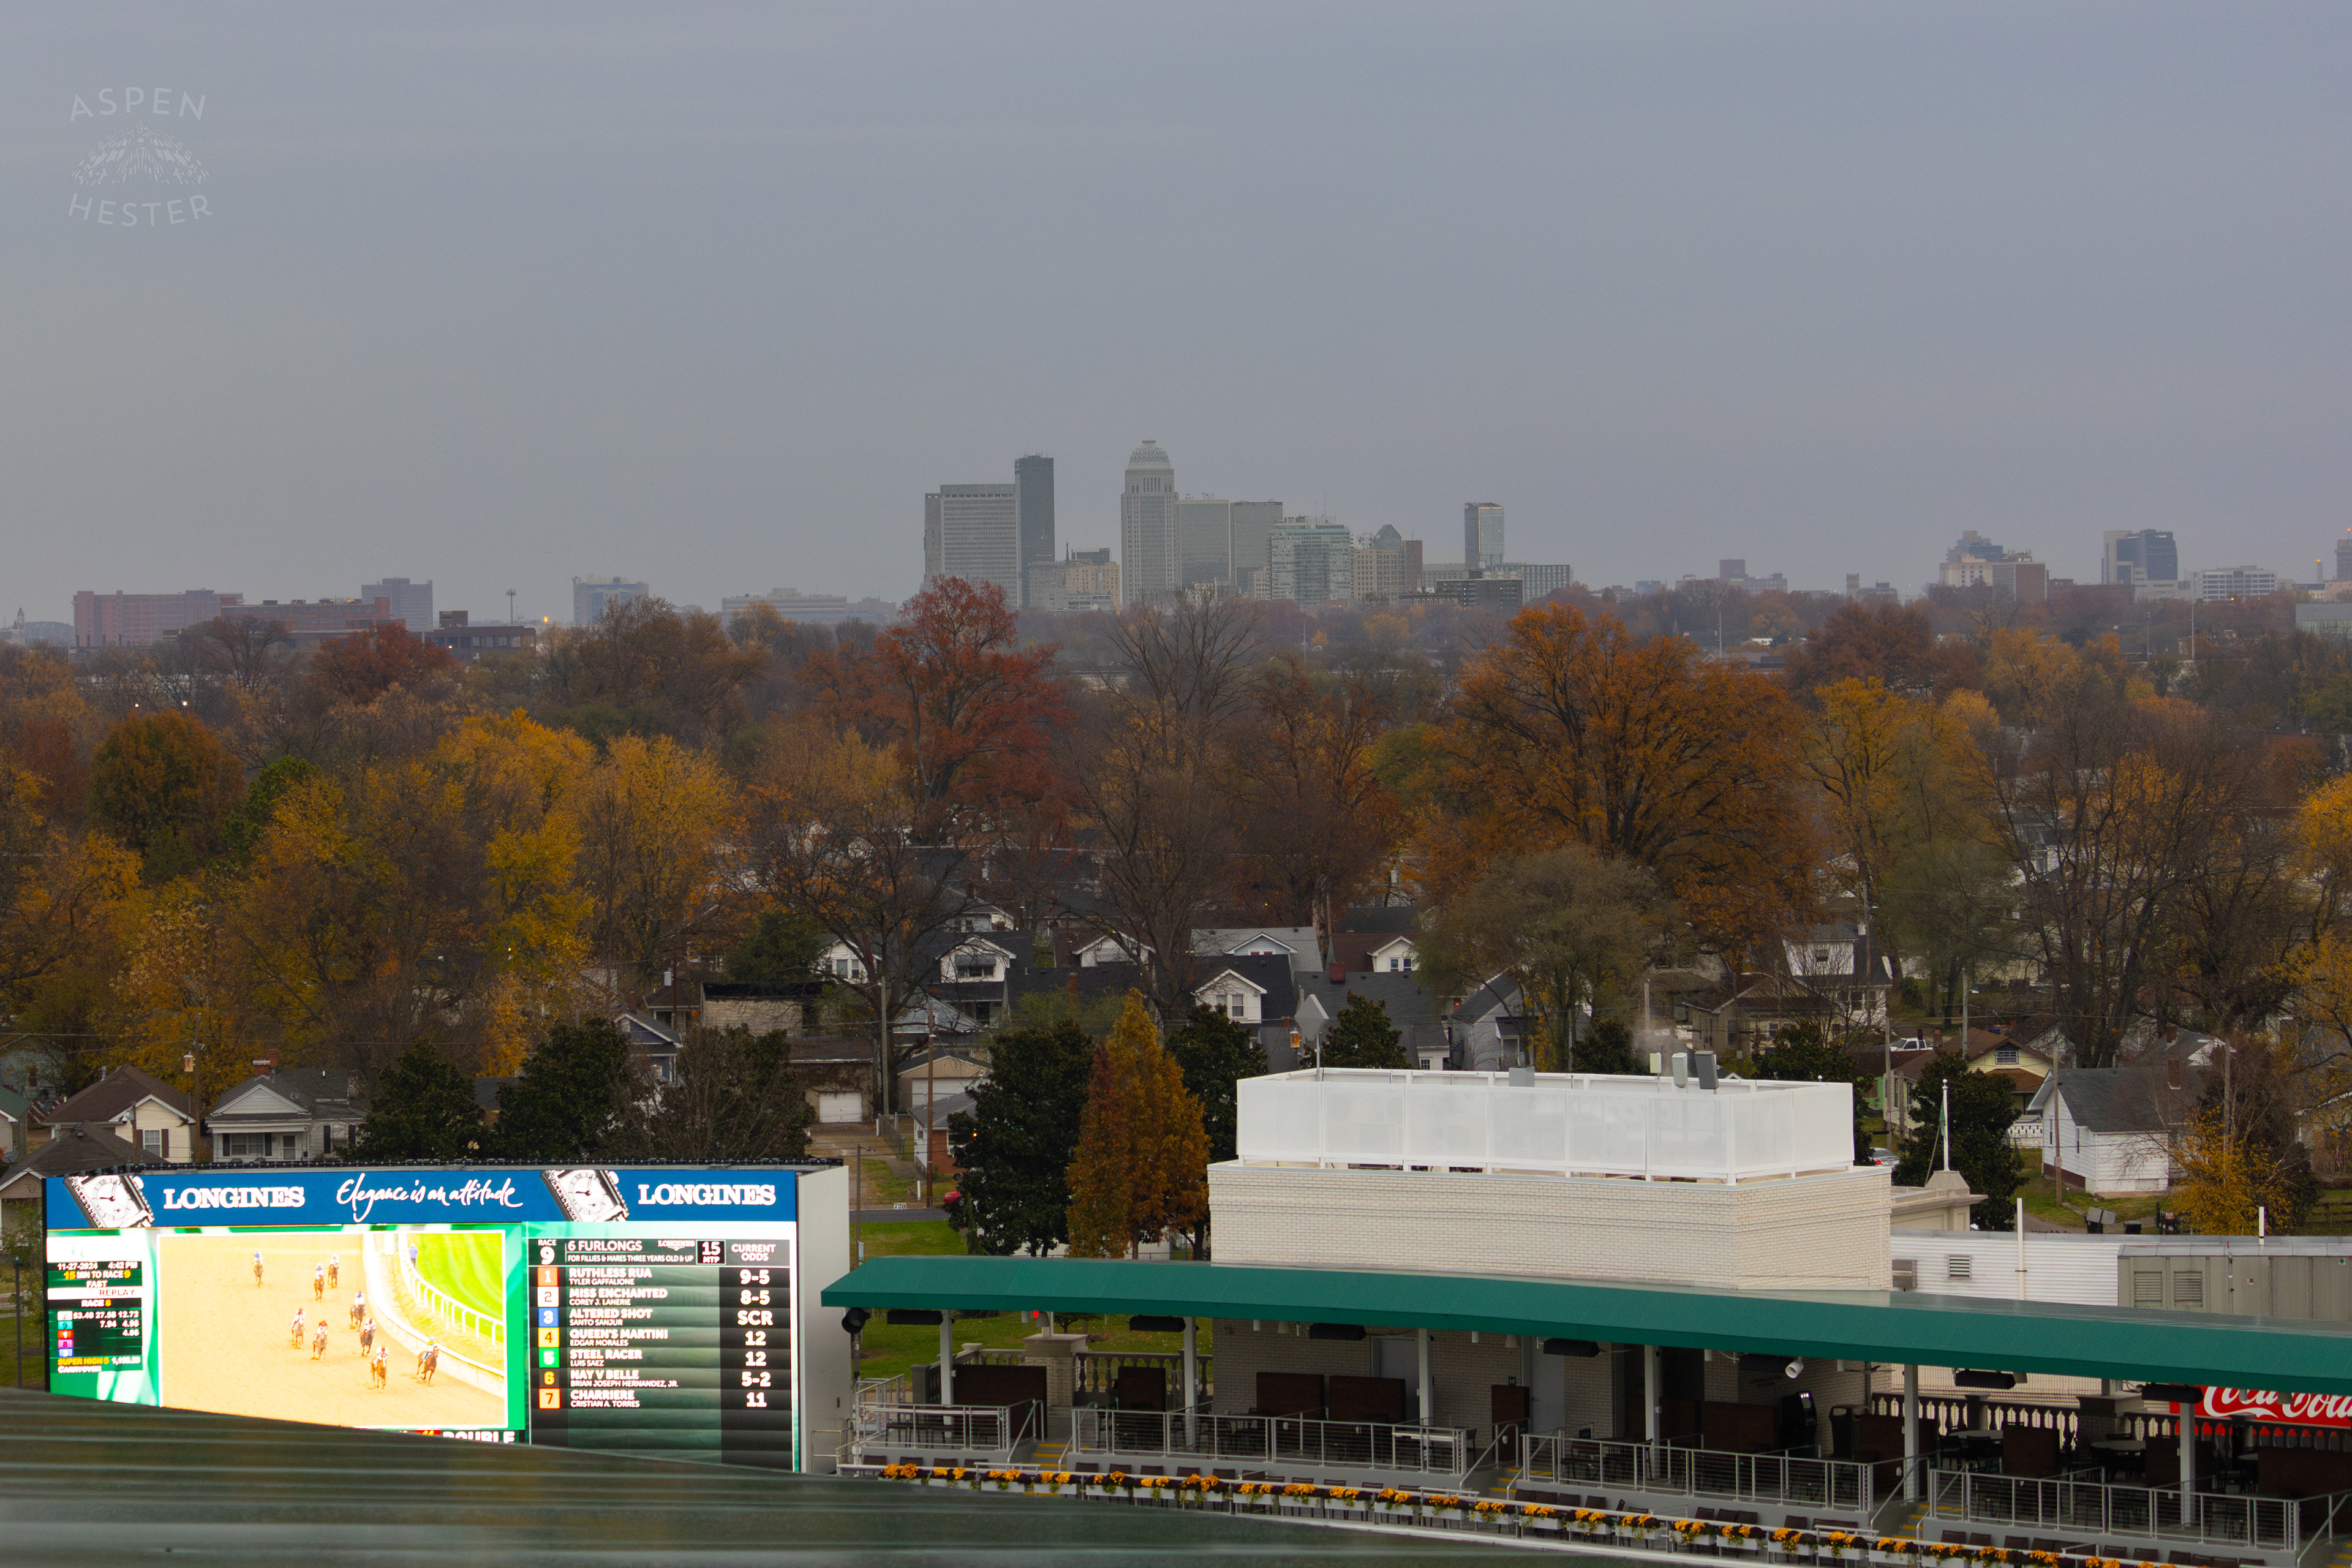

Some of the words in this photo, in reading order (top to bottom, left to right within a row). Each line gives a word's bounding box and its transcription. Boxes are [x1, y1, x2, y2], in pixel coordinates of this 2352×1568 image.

[163, 1186, 306, 1209] LONGINES
[336, 1172, 409, 1223] Elegance
[410, 1179, 426, 1204] is
[428, 1186, 450, 1206] an
[449, 1177, 524, 1208] attitude
[638, 1183, 777, 1205] LONGINES
[567, 1240, 576, 1251] 6
[578, 1240, 643, 1251] FURLONGS
[701, 1241, 721, 1256] 15
[731, 1244, 777, 1253] CURRENT
[540, 1246, 555, 1265] 9
[741, 1253, 769, 1262] ODDS
[63, 1271, 76, 1280] 15
[76, 1271, 91, 1280] MIN
[91, 1270, 102, 1279] TO
[102, 1270, 124, 1279] RACE
[124, 1270, 132, 1279] 9
[544, 1270, 552, 1283] 1
[568, 1268, 627, 1278] RUTHLESS
[628, 1268, 652, 1278] RUA
[739, 1269, 771, 1285] 9-5
[545, 1291, 552, 1302] 2
[569, 1288, 597, 1298] MISS
[598, 1288, 668, 1298] ENCHANTED
[740, 1289, 771, 1305] 8-5
[81, 1299, 105, 1308] RACE
[543, 1310, 554, 1324] 3
[569, 1309, 620, 1319] ALTERED
[620, 1309, 653, 1319] SHOT
[737, 1310, 774, 1325] SCR
[545, 1332, 552, 1343] 4
[569, 1329, 619, 1340] QUEEN'S
[620, 1329, 668, 1339] MARTINI
[745, 1331, 766, 1346] 12
[543, 1351, 555, 1365] 5
[570, 1349, 604, 1359] STEEL
[605, 1349, 643, 1359] RACER
[745, 1351, 767, 1366] 12
[544, 1371, 554, 1385] 6
[570, 1370, 594, 1380] NAY
[594, 1370, 605, 1379] V
[605, 1370, 639, 1380] BELLE
[741, 1371, 771, 1387] 5-2
[622, 1380, 667, 1389] HERNANDEZ,
[545, 1392, 554, 1405] 7
[570, 1390, 635, 1400] CHARRIERE
[746, 1392, 767, 1408] 11
